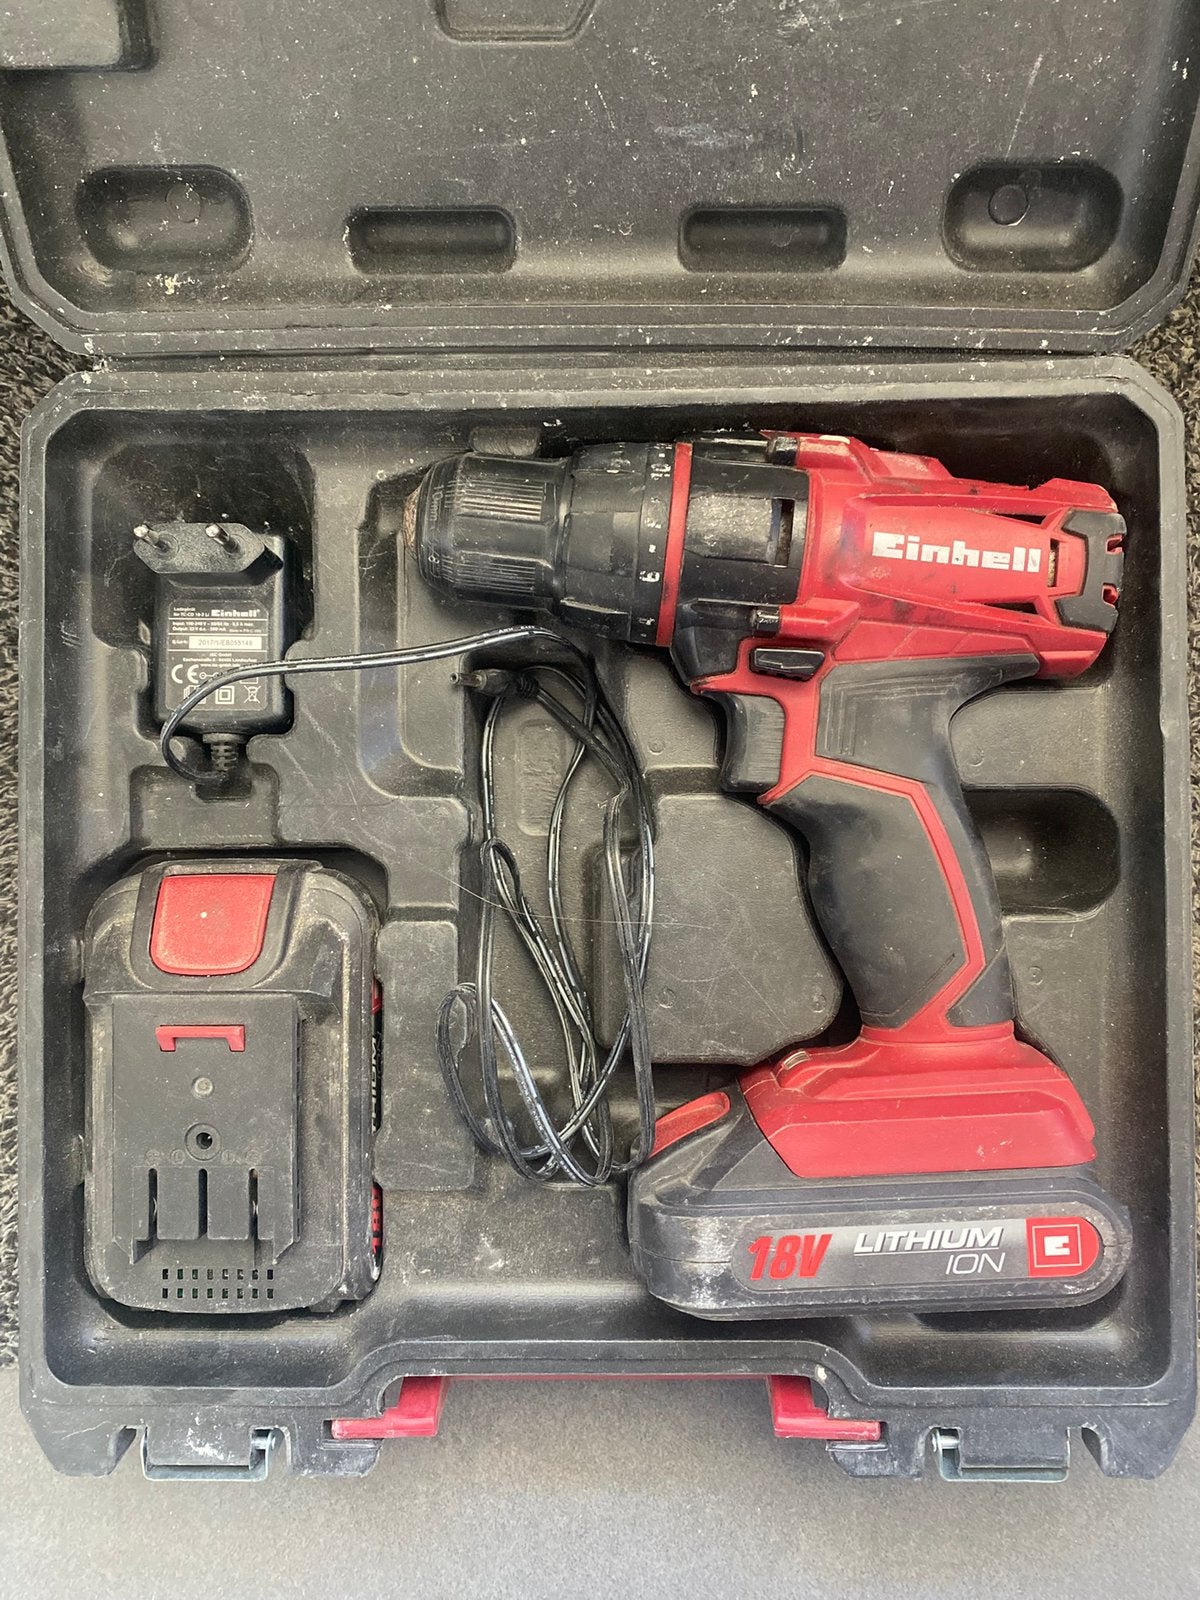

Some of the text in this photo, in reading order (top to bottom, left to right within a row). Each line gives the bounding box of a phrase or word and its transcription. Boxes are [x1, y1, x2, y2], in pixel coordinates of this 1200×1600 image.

[872, 531, 1041, 572] Einhell
[211, 609, 257, 618] Einhell
[854, 1227, 1004, 1252] LITHIUM
[747, 1233, 833, 1281] 18V
[945, 1252, 1006, 1275] ION
